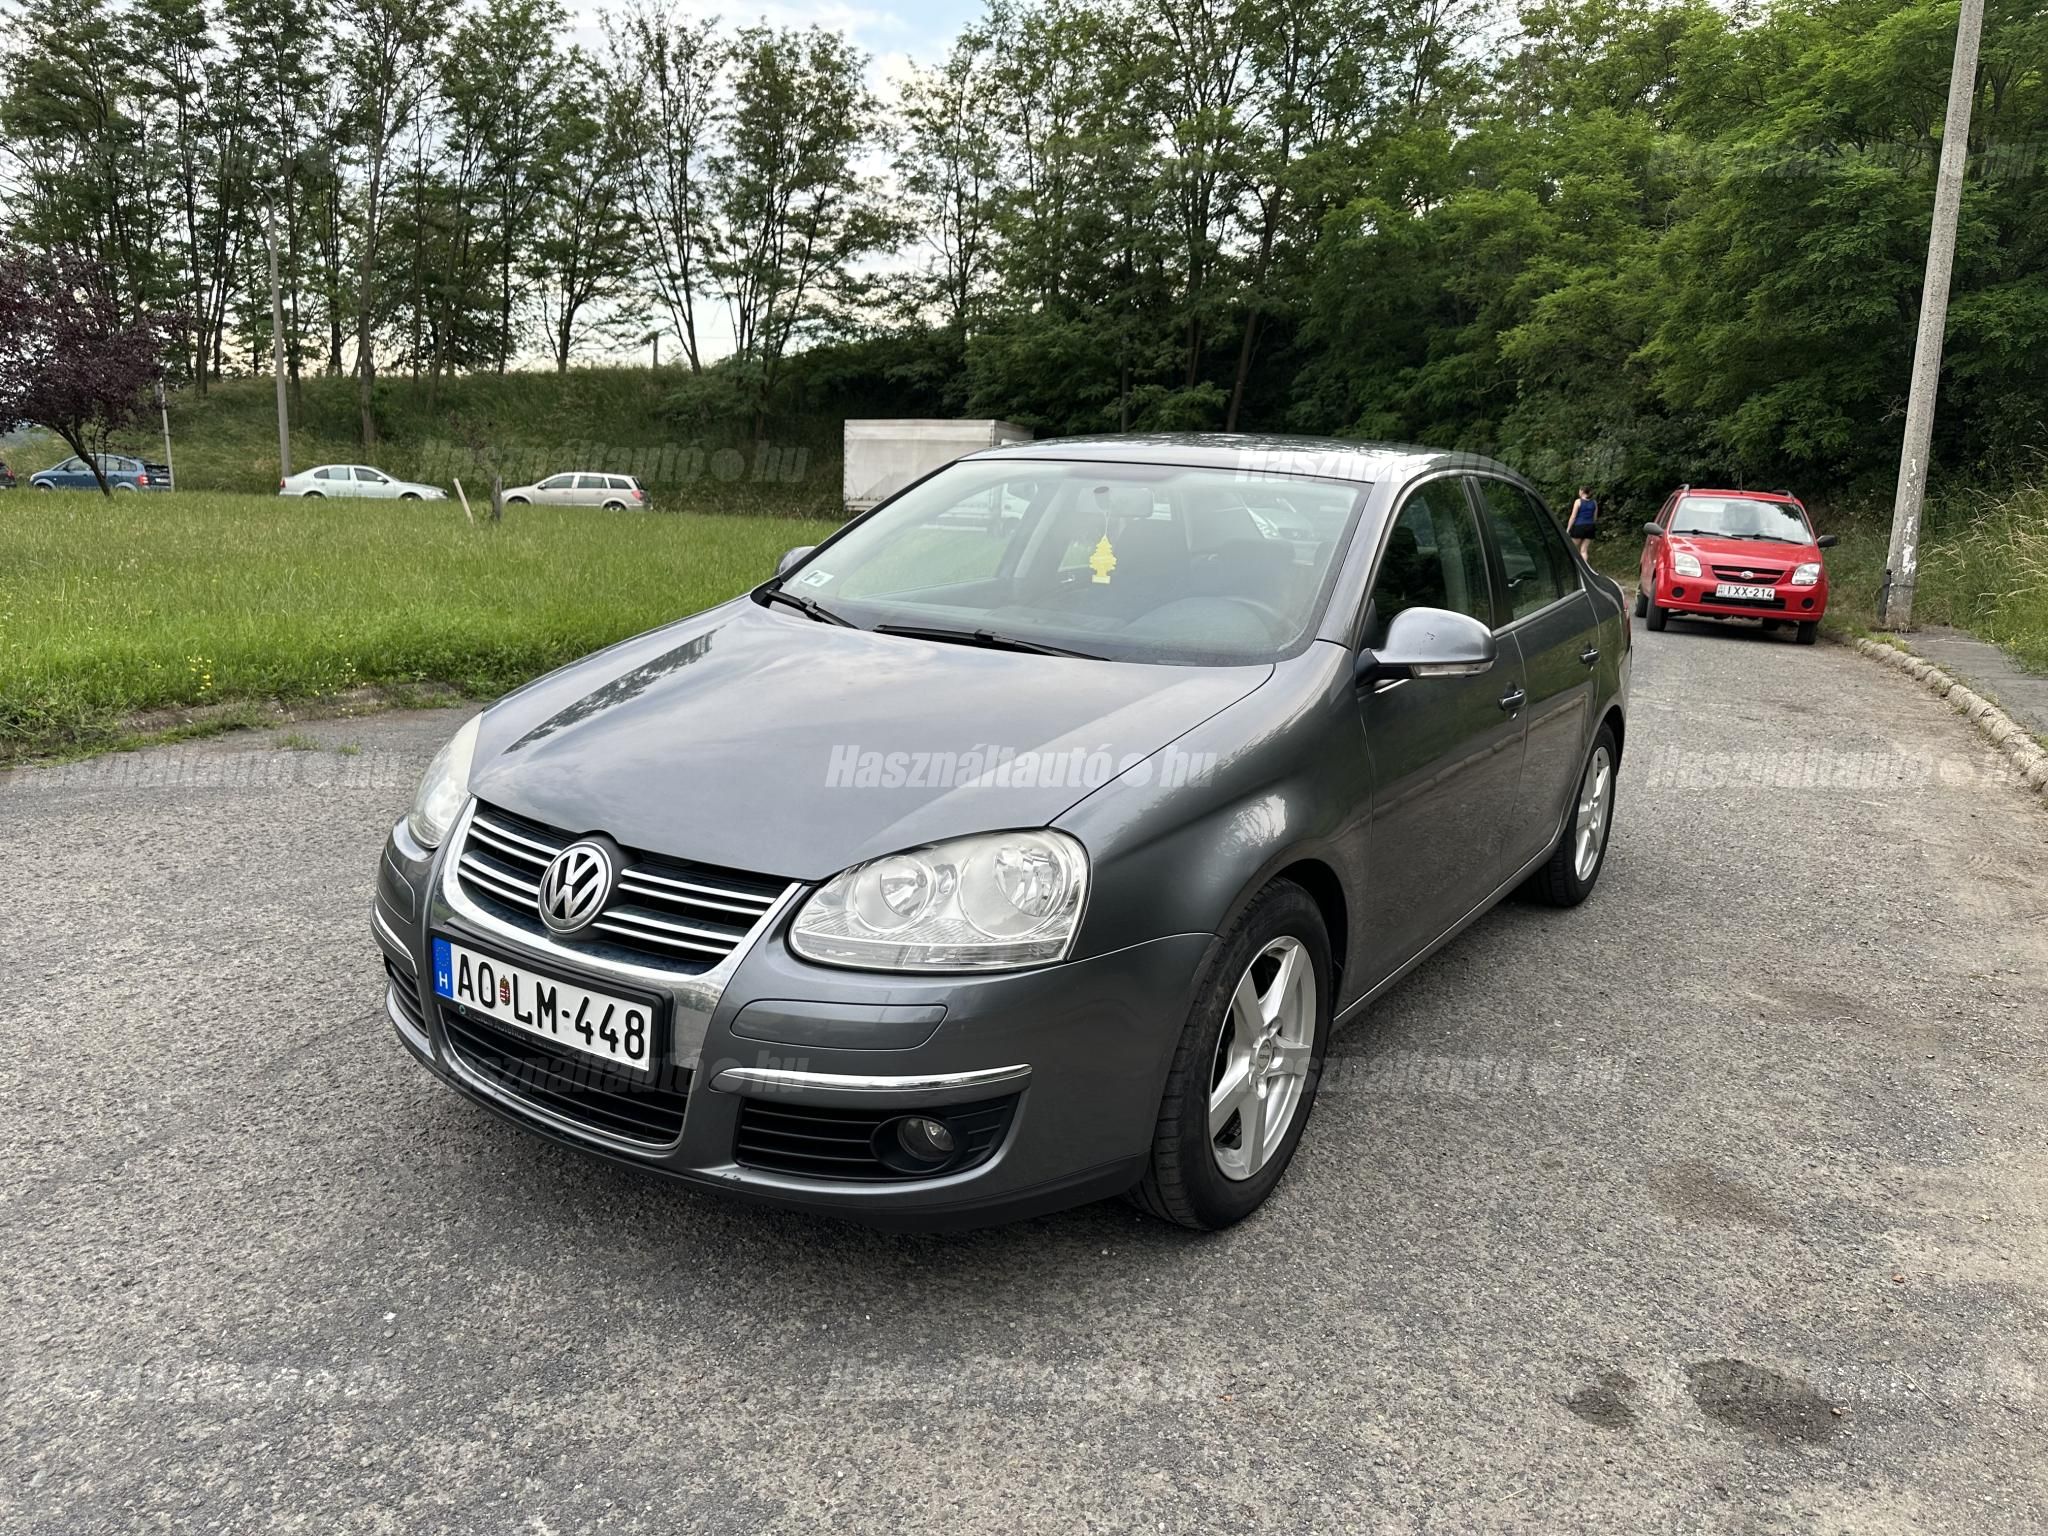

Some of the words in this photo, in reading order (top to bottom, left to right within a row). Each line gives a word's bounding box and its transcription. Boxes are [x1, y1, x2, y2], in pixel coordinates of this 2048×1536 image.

[1727, 586, 1773, 599] IXX-214
[438, 971, 449, 990] H
[512, 973, 646, 1061] LM-448
